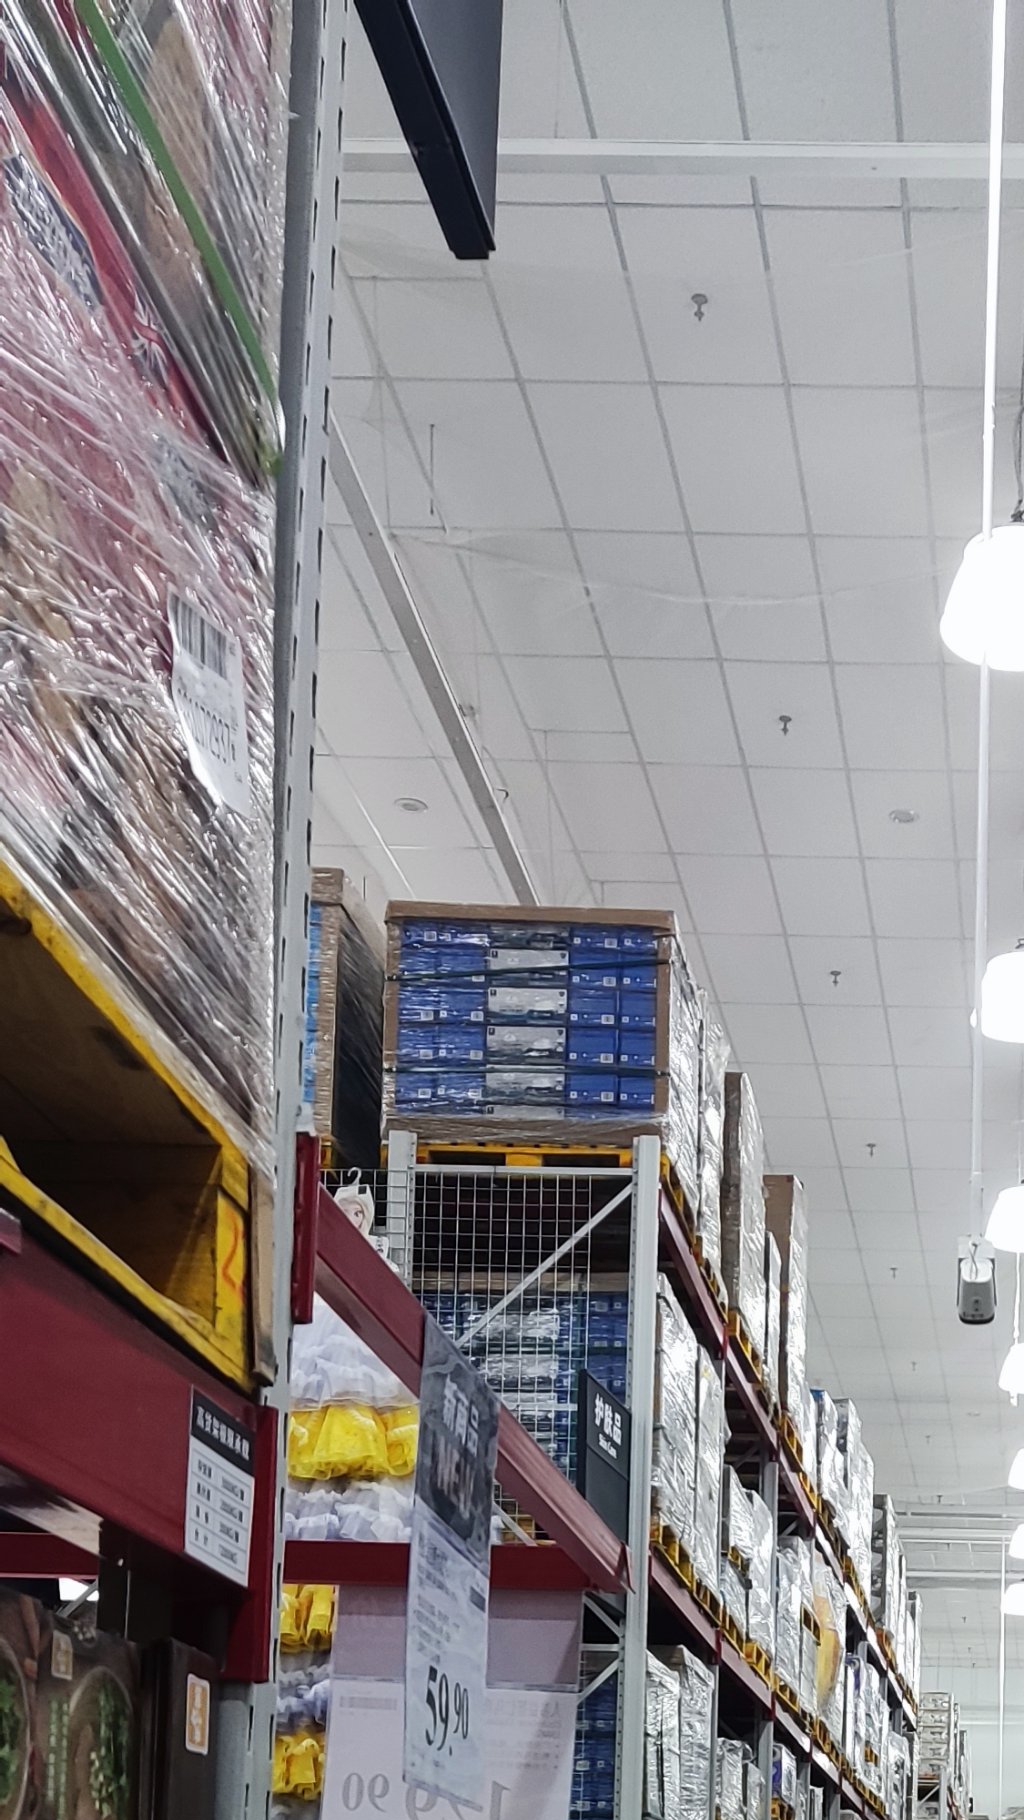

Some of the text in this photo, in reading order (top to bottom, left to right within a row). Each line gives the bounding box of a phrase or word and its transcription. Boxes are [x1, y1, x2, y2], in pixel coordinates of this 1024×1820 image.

[443, 1373, 479, 1458] 新商品
[594, 1392, 622, 1446] 护肤品
[425, 1665, 469, 1757] 59.90
